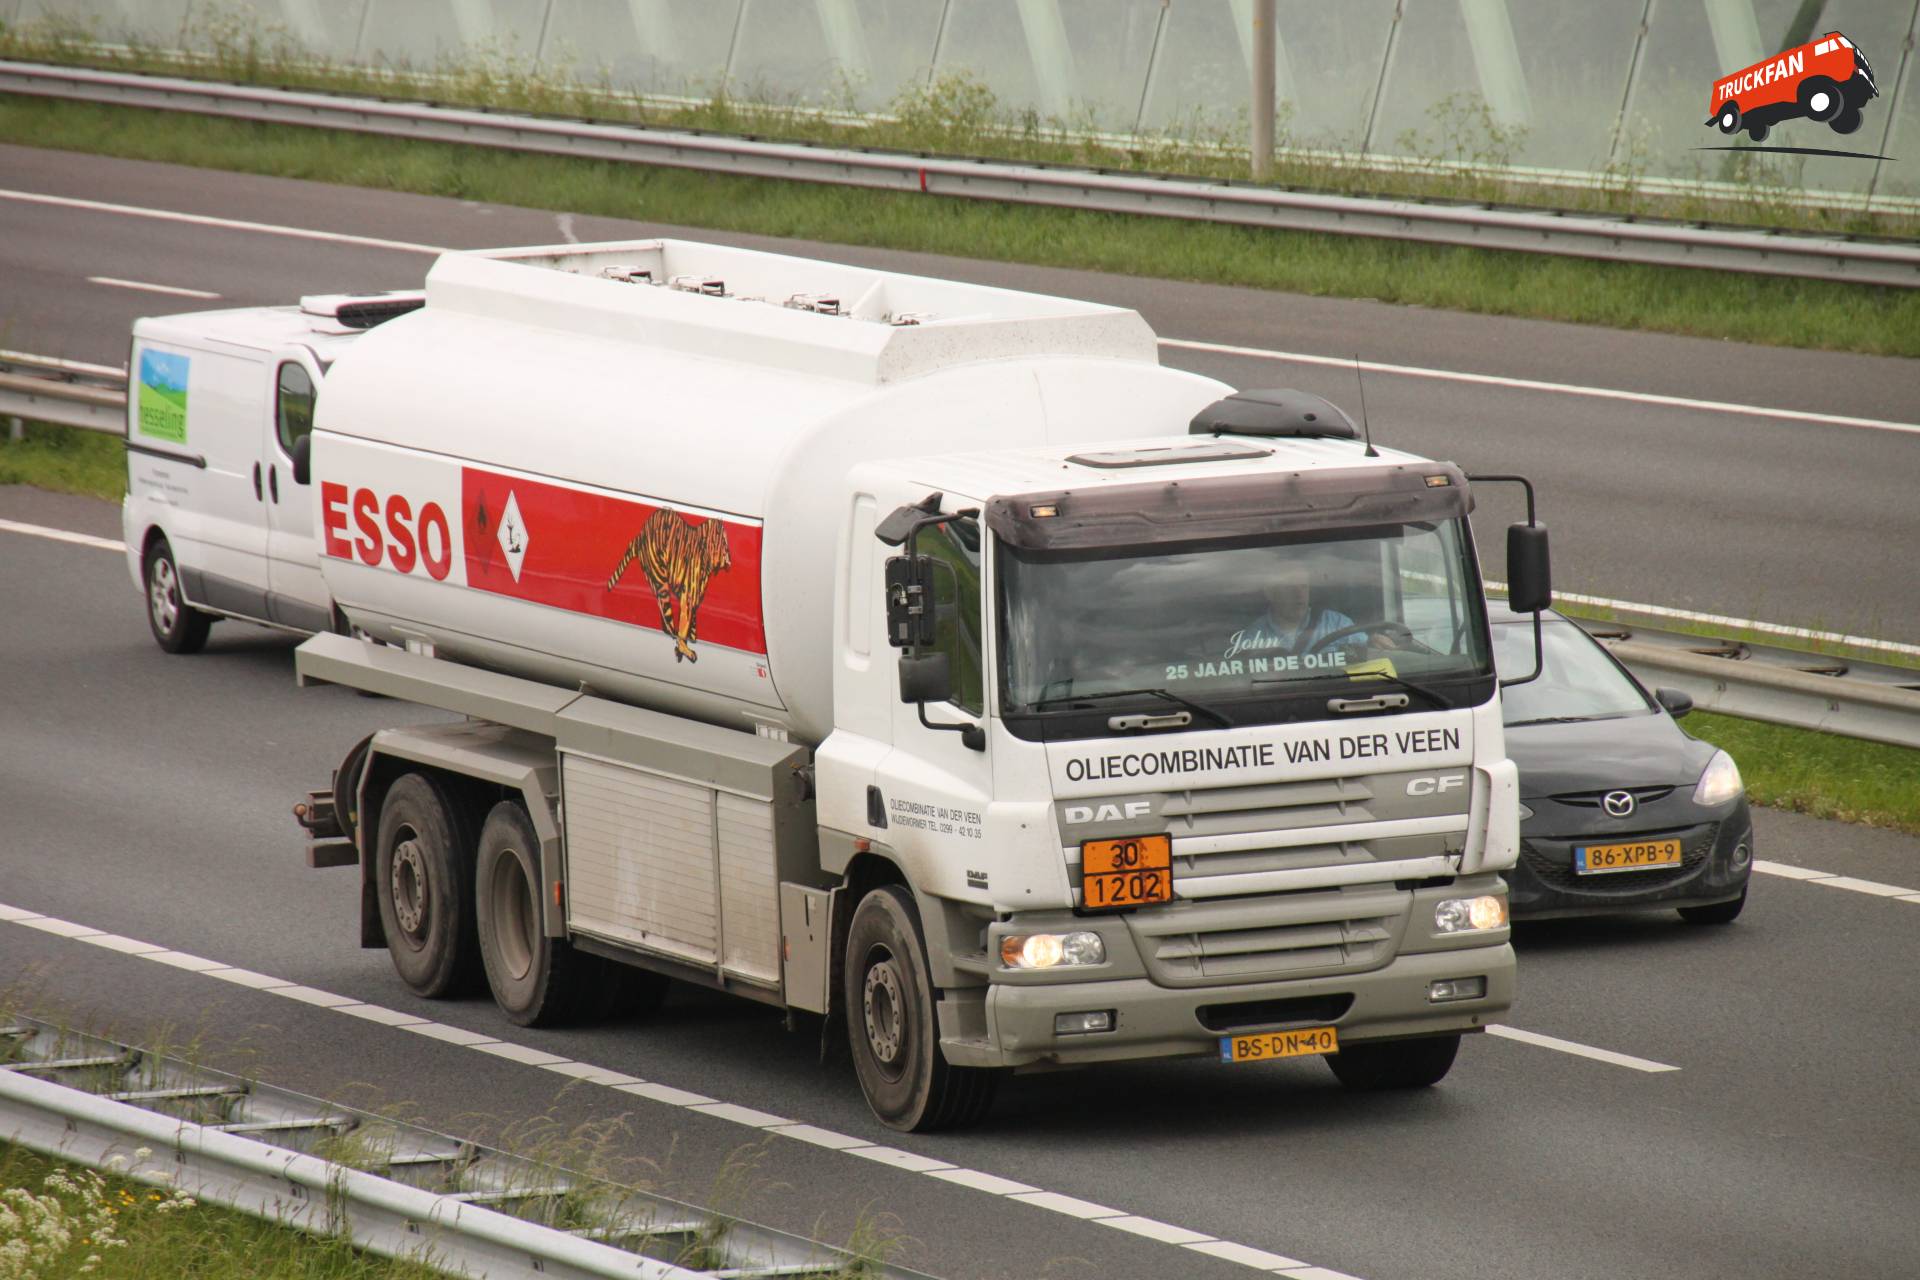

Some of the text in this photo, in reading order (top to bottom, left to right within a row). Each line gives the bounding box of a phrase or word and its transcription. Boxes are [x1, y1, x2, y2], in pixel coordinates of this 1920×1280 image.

[321, 480, 453, 582] ESSO
[1223, 629, 1282, 659] John
[1165, 652, 1347, 680] 25 JAAR IN DE OLIE
[1065, 727, 1460, 782] OLIECOMBINATIE VAN DER VEEN
[1406, 775, 1465, 796] CF
[890, 798, 982, 825] OLIECOMBINATIE VAN DER VEEN
[1064, 801, 1151, 824] DAF
[1110, 842, 1138, 868] 30
[1592, 844, 1674, 866] 86-XPB-9
[1095, 873, 1161, 904] 1202
[1237, 1031, 1332, 1058] BS-DN-40
